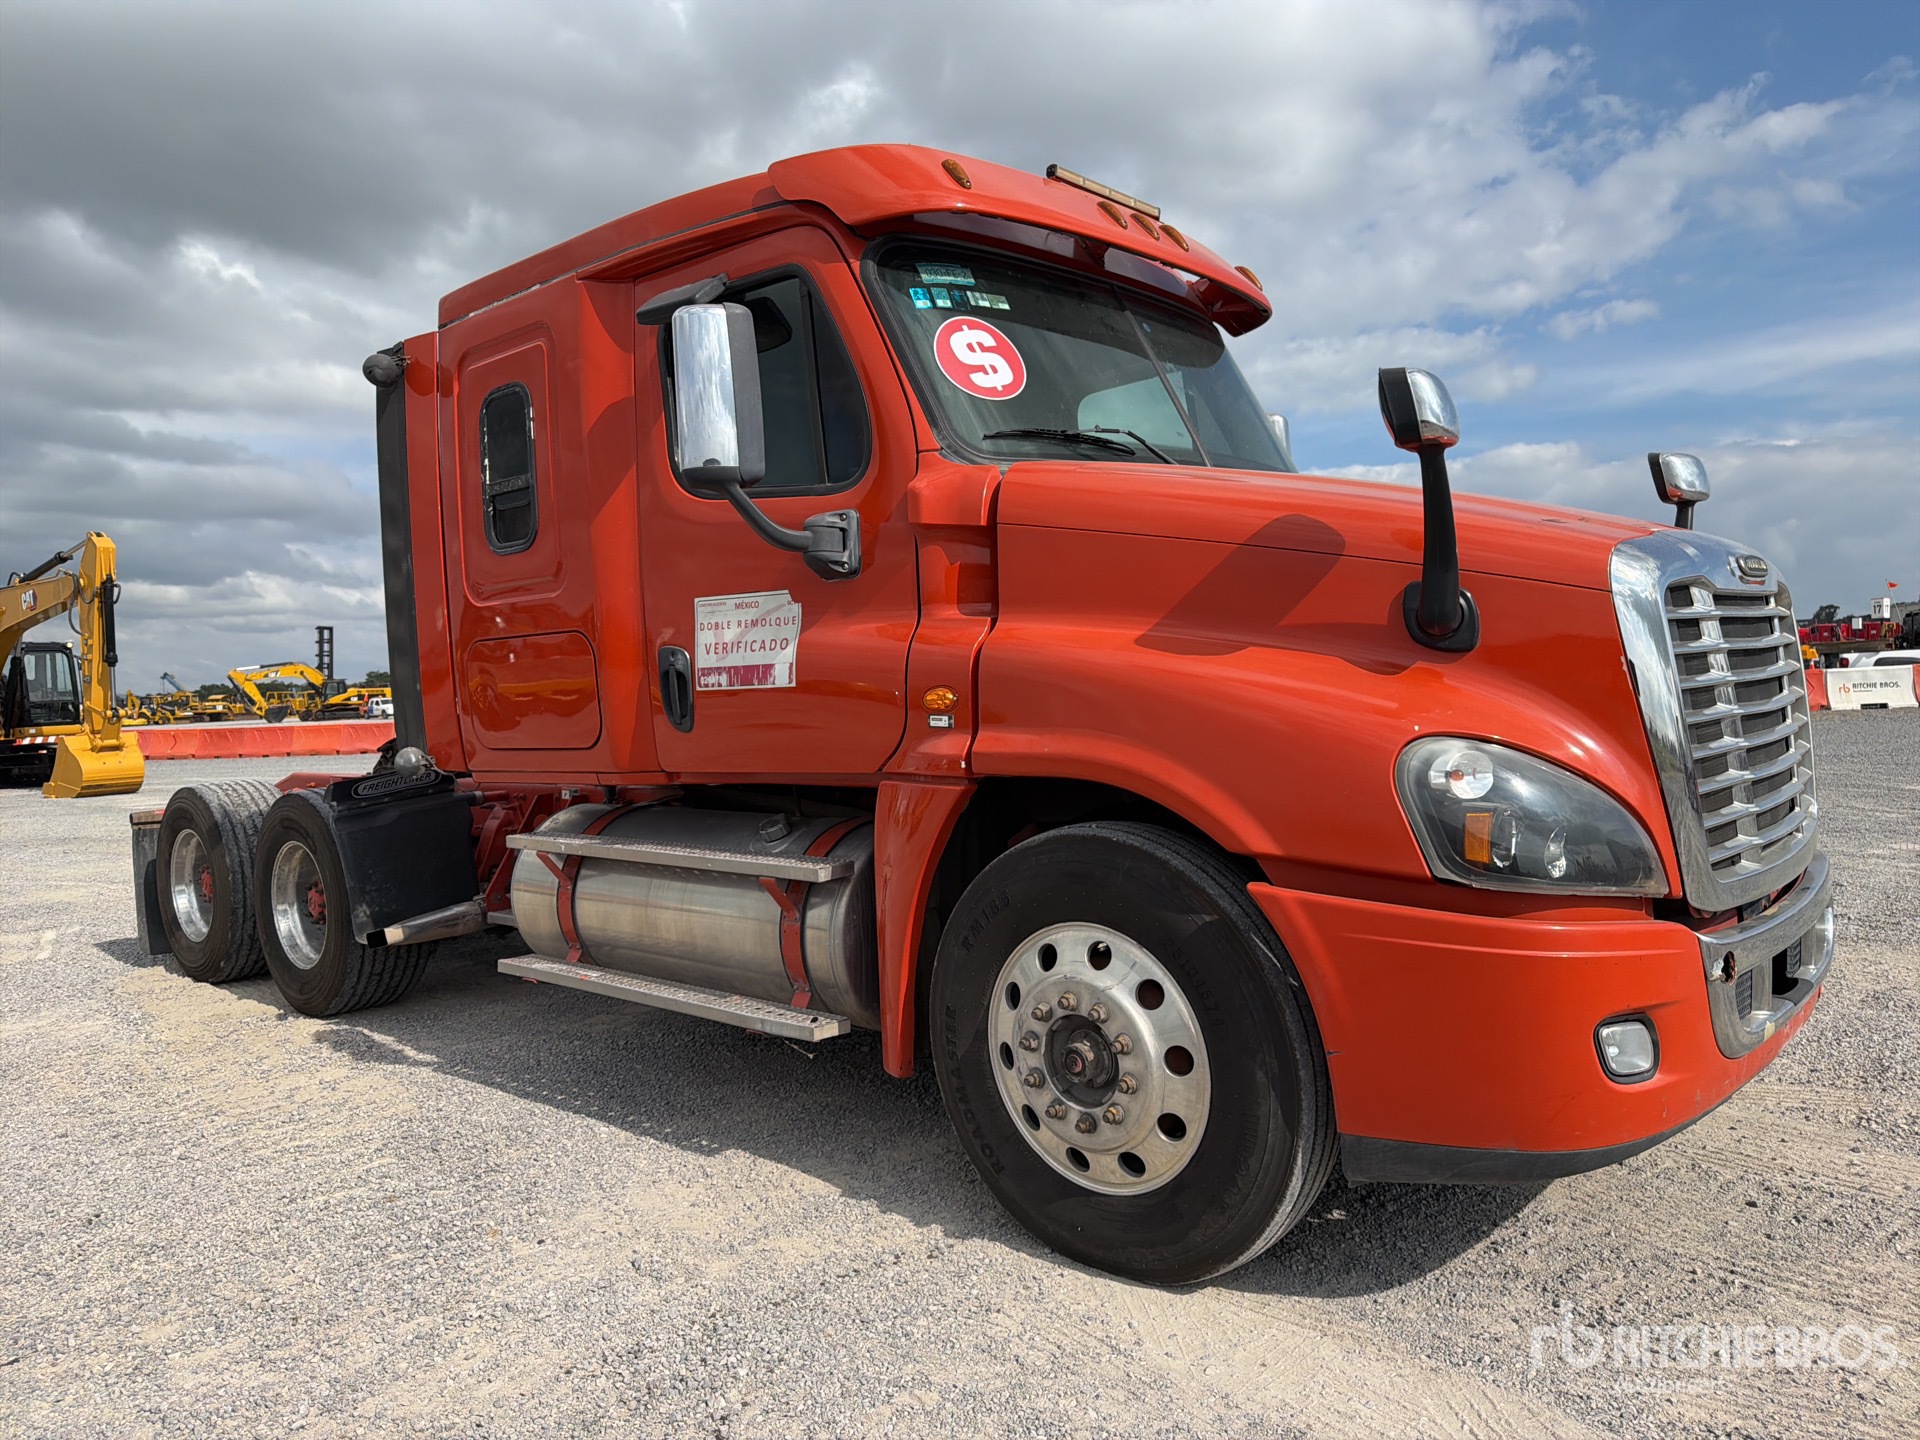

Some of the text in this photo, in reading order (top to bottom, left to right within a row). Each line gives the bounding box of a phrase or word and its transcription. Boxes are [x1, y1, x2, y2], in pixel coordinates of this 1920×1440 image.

[22, 589, 34, 611] CAT
[734, 600, 760, 611] MÉXICO
[1873, 604, 1882, 615] 17
[700, 616, 797, 631] DOBLE REMOLQUE
[704, 637, 789, 655] VERIFICADO
[1838, 683, 1851, 694] rb
[1852, 681, 1901, 690] RITCHIE BROS.
[944, 1004, 1005, 1176] ROADMASTER
